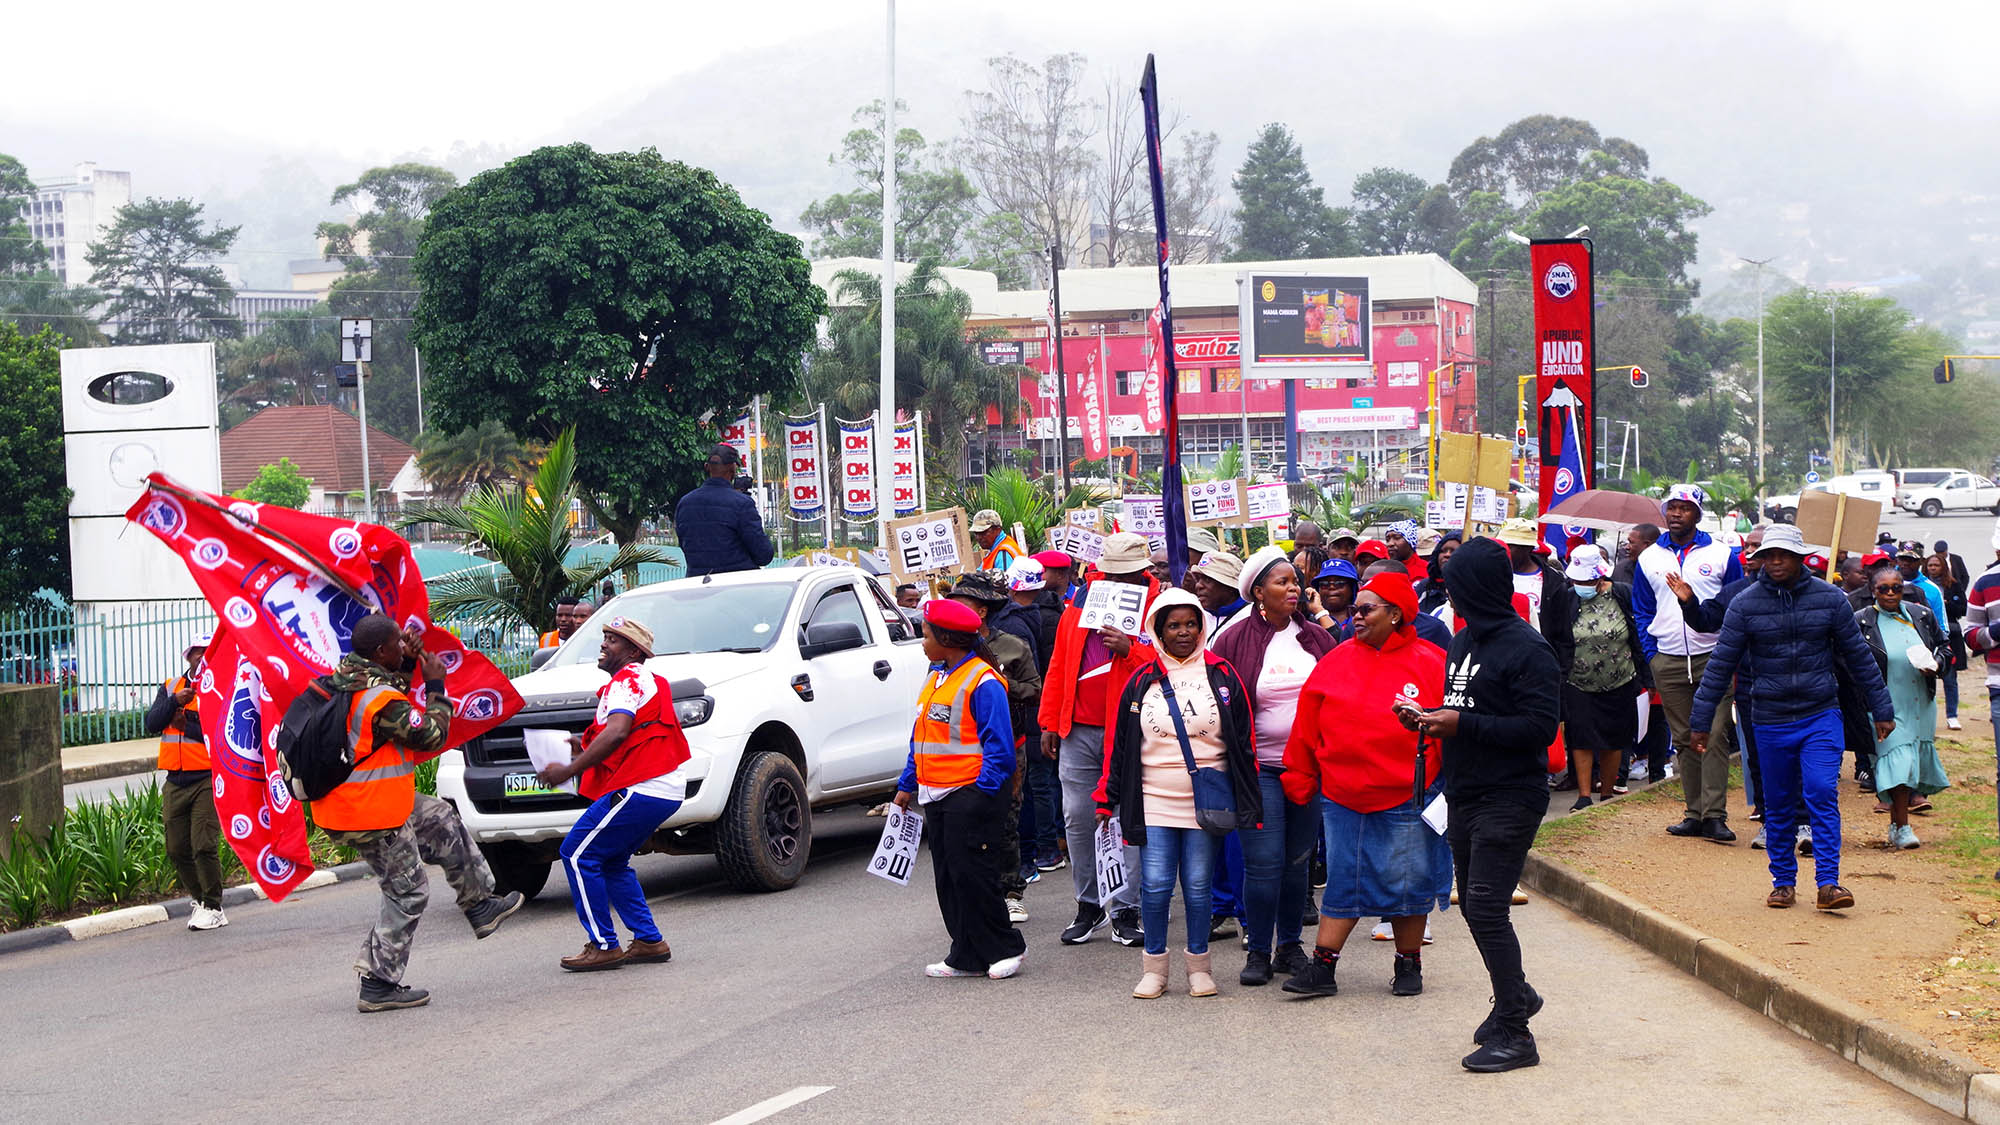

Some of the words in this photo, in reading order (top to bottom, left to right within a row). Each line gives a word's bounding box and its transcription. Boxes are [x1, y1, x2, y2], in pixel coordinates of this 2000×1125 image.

[790, 430, 813, 444] OK
[846, 436, 867, 449] OK
[792, 458, 815, 472] OK
[847, 462, 868, 476] OK
[794, 486, 817, 500] OK
[848, 489, 870, 502] OK
[1218, 499, 1235, 508] FUND
[931, 544, 954, 557] FUND
[903, 816, 916, 843] FUND
